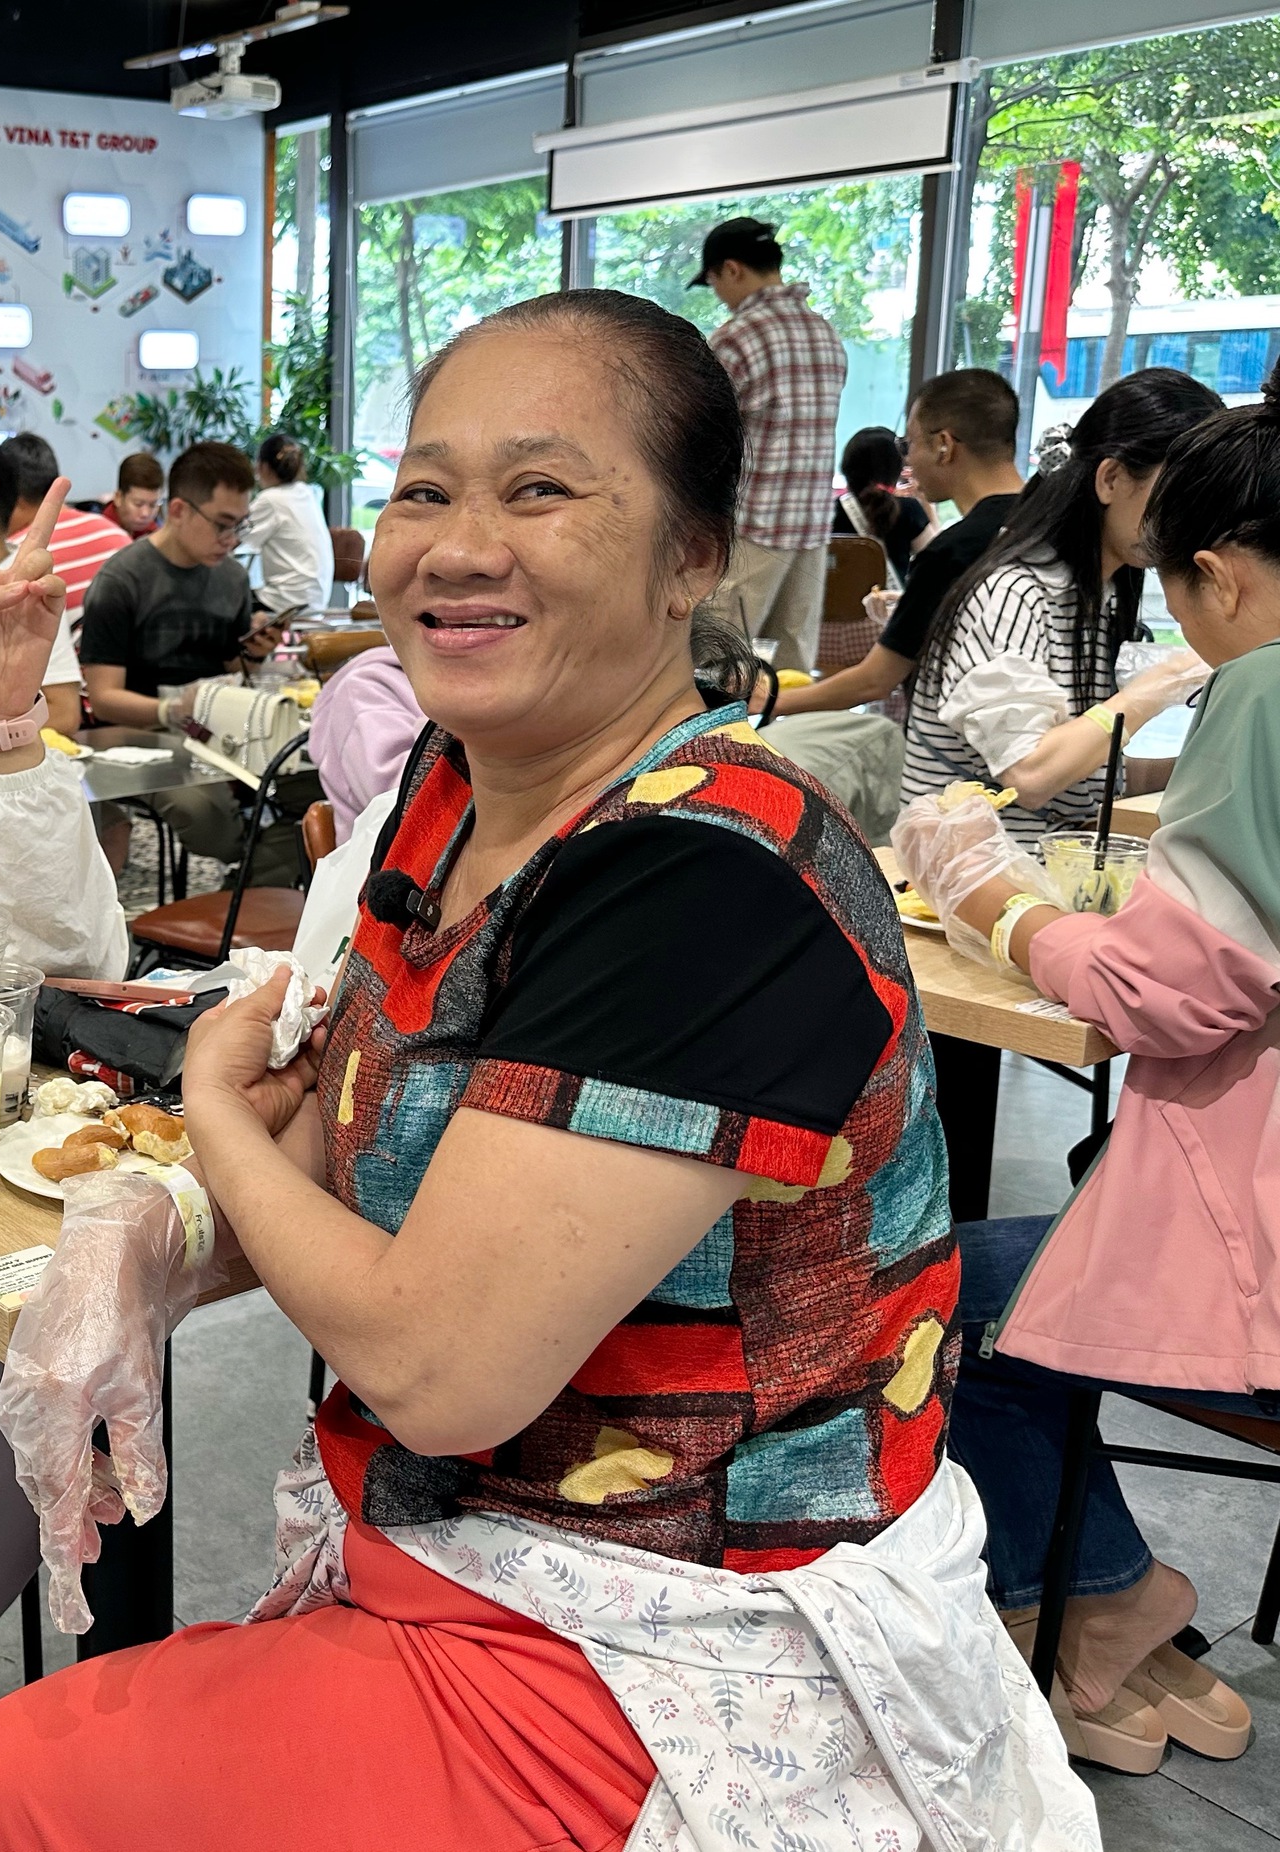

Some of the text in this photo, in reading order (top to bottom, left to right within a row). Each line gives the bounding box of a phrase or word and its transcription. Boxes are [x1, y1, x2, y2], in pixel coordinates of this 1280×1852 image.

[3, 126, 52, 145] VINA
[58, 129, 91, 149] T&T
[96, 132, 158, 154] GROUP
